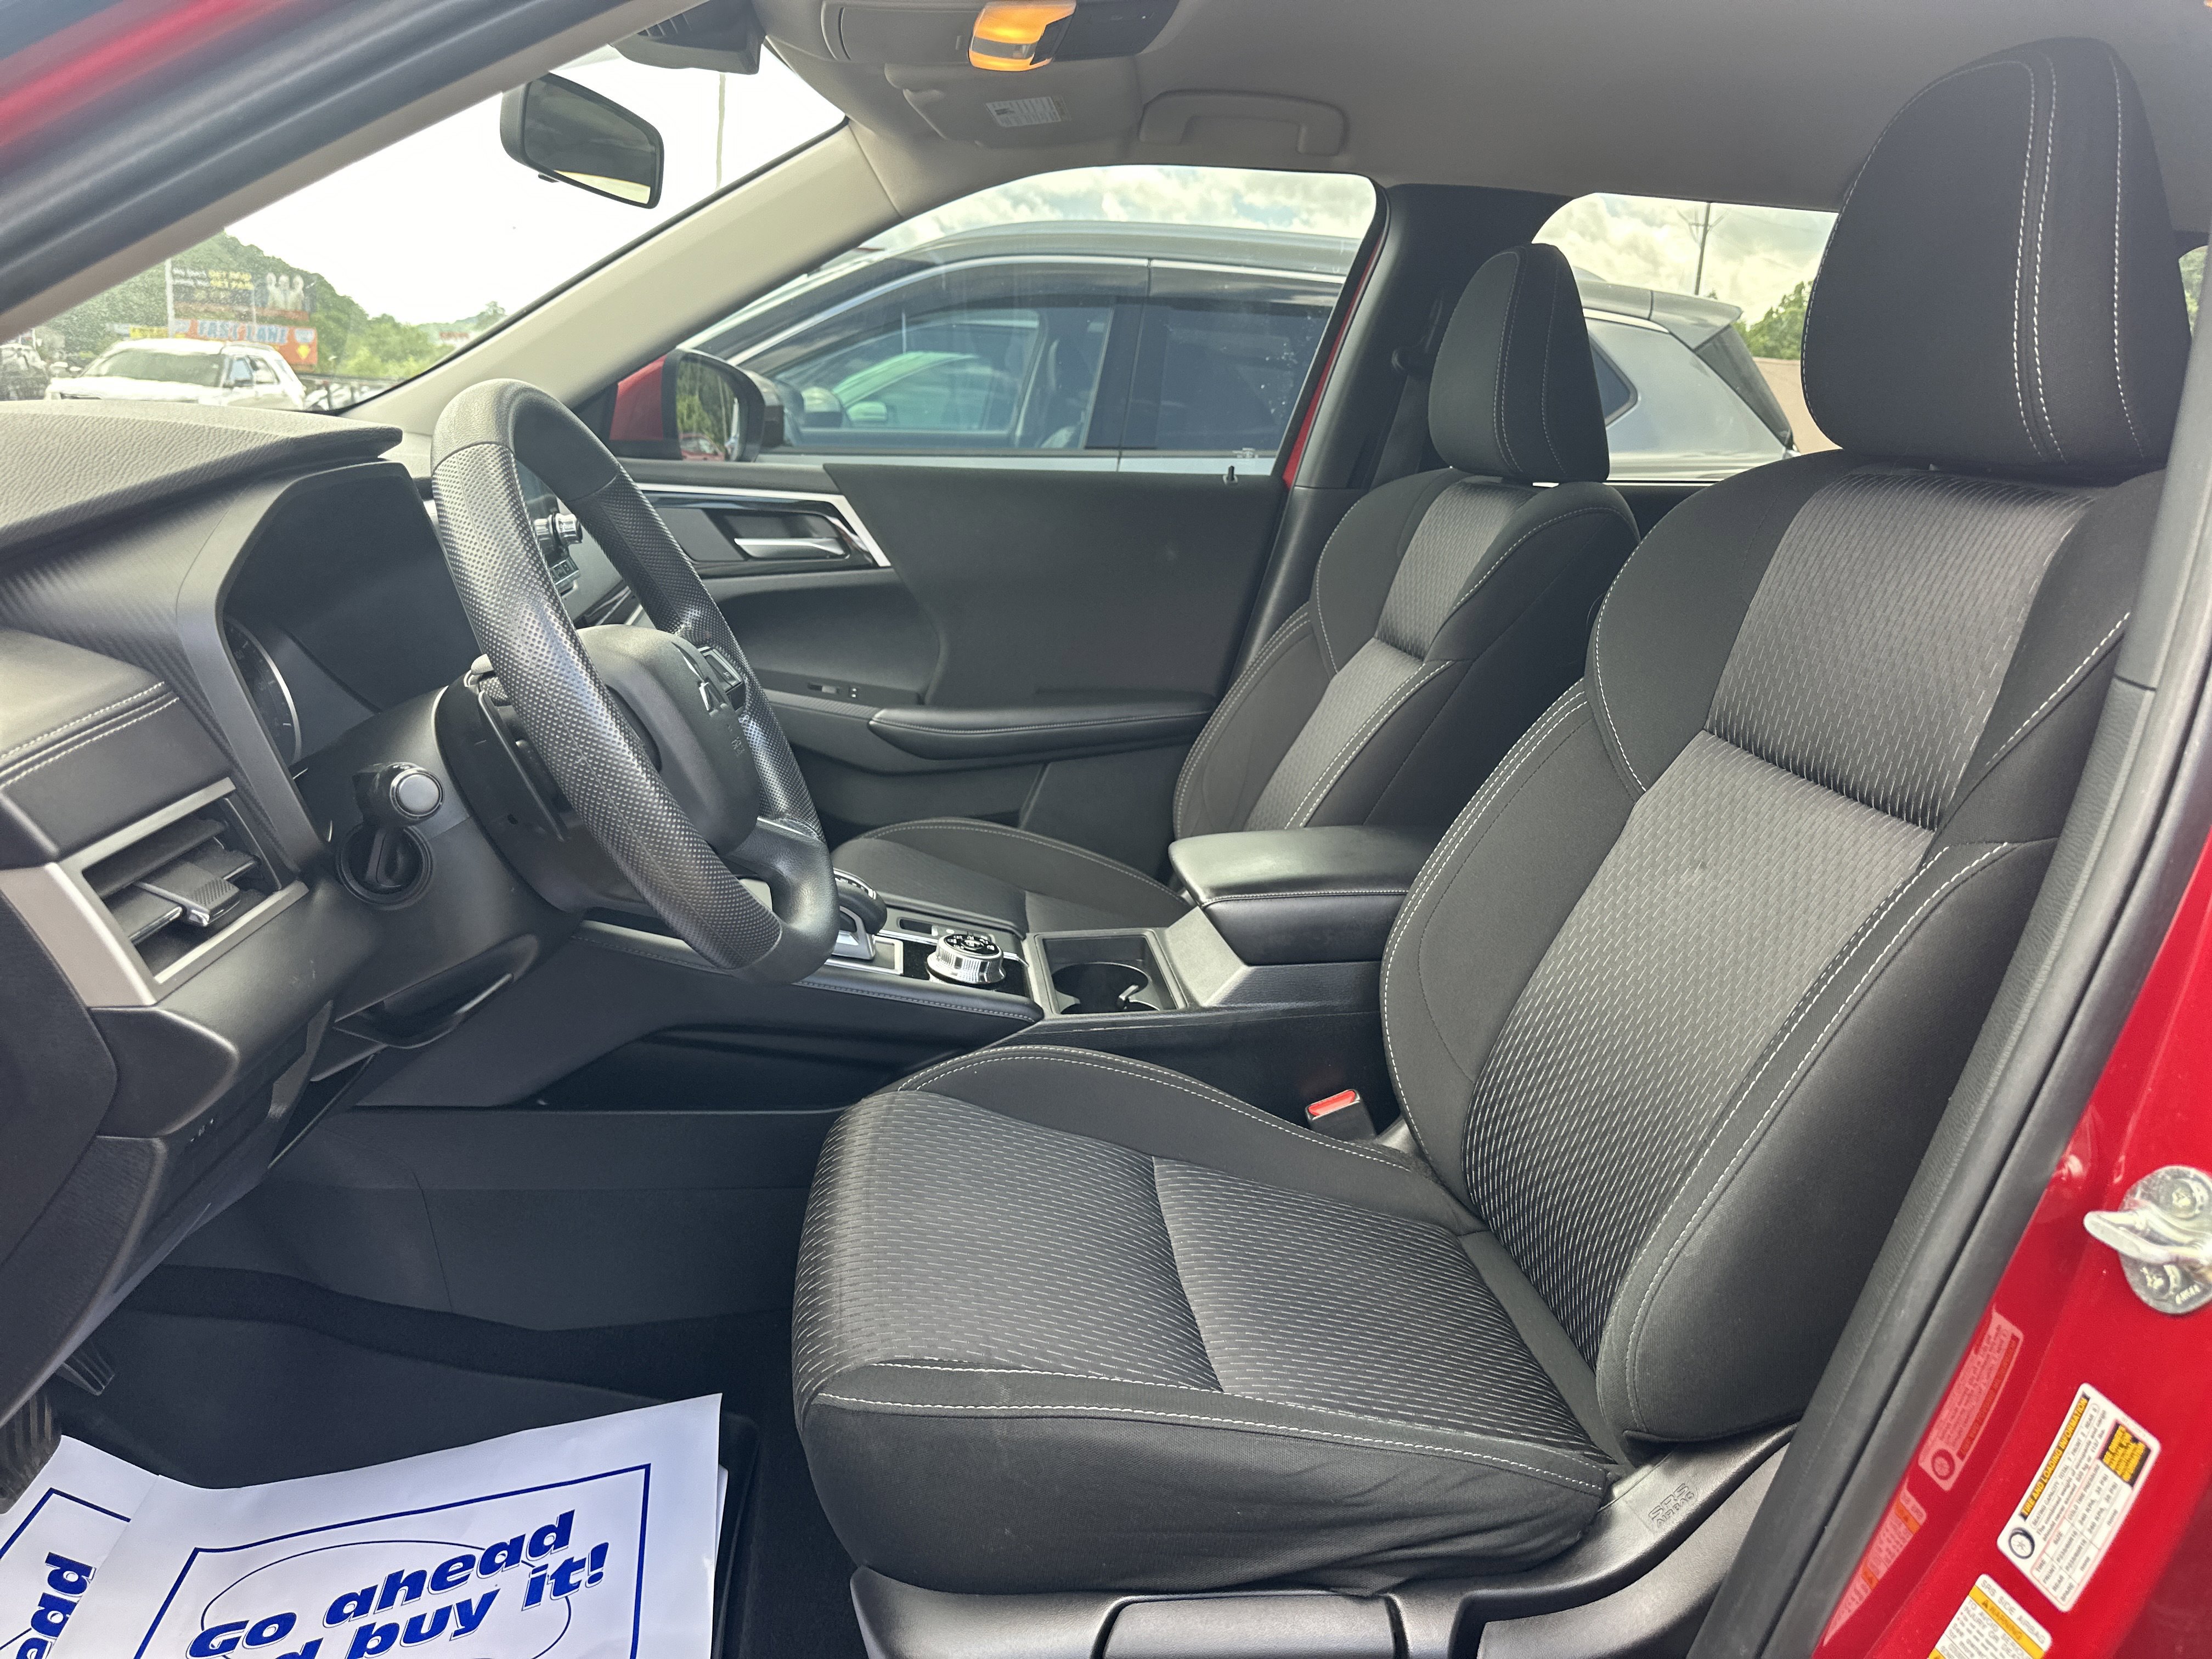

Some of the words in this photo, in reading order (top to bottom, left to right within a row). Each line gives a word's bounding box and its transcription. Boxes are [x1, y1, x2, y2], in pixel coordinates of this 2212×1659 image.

[198, 320, 238, 340] FAST
[2022, 1497, 2035, 1516] TIRE
[2031, 1480, 2045, 1500] AND
[2040, 1447, 2063, 1483] LOADING
[2057, 1398, 2089, 1448] INFORMATION
[1648, 1483, 1689, 1521] SRS
[1656, 1491, 1695, 1528] AIRBAG
[185, 1612, 297, 1658] Go
[323, 1509, 575, 1628] ahead
[345, 1588, 501, 1659] buy
[521, 1542, 609, 1611] it!
[1980, 1579, 1996, 1597] SRS
[1997, 1596, 2016, 1615] SIDE
[2017, 1615, 2046, 1645] AIRBAG
